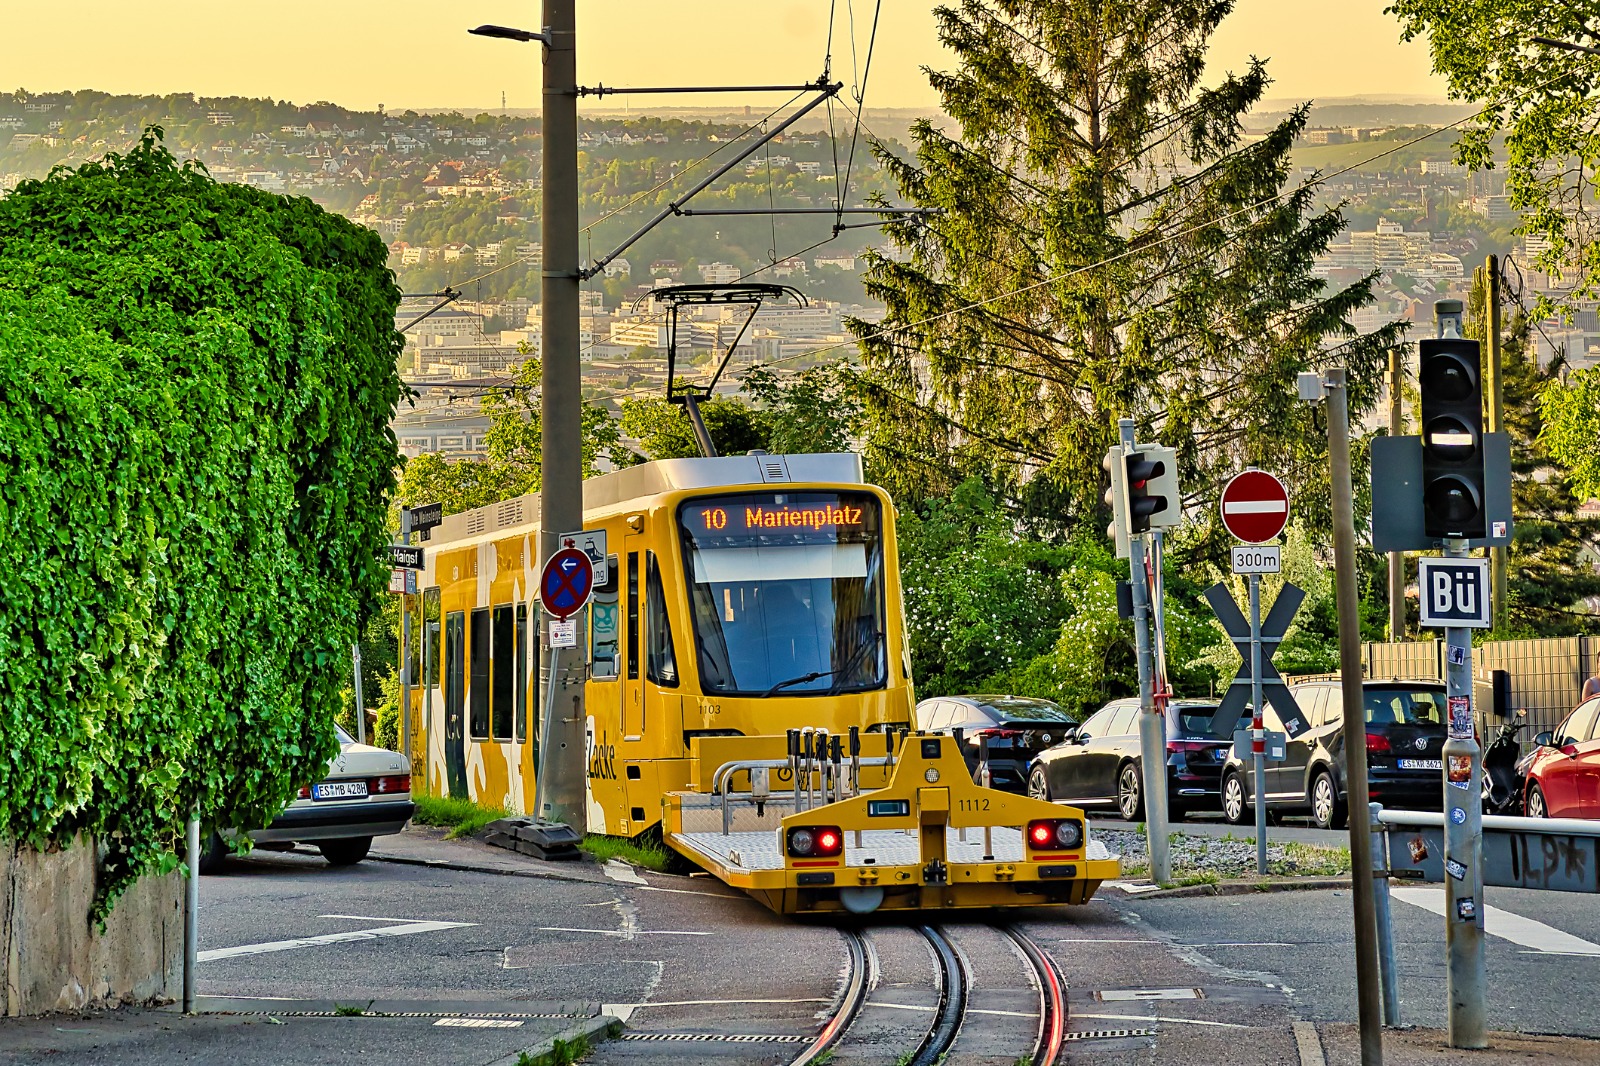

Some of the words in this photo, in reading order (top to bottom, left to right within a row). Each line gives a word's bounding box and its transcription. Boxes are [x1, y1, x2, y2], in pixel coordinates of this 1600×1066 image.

[701, 508, 727, 530] 10
[745, 504, 862, 530] Marienplatz
[393, 549, 418, 566] Haigst
[1432, 571, 1476, 614] Bü
[699, 705, 721, 714] 1103
[586, 730, 617, 780] Zacke
[1402, 760, 1412, 768] ES
[318, 785, 330, 797] ES
[334, 784, 346, 796] MB
[347, 782, 367, 795] 428H
[958, 799, 991, 811] 1112
